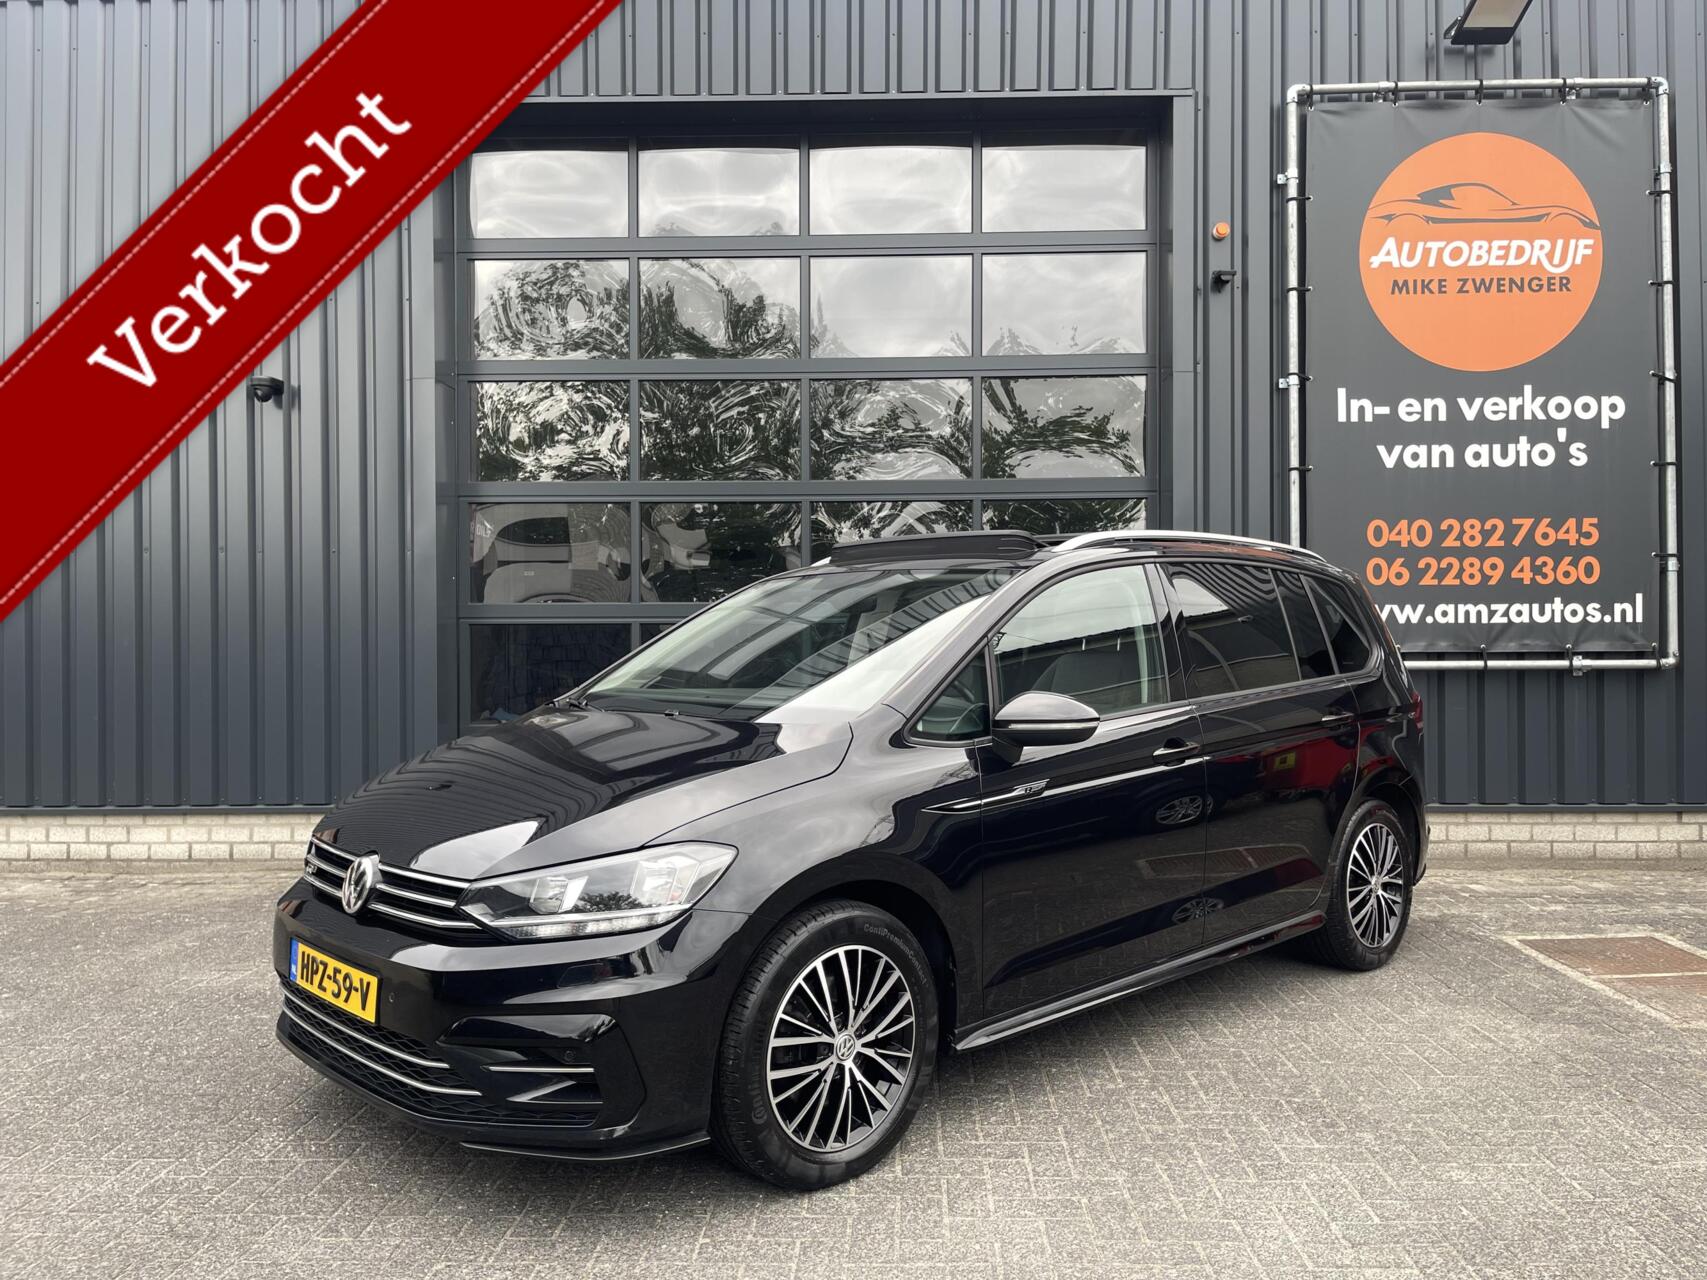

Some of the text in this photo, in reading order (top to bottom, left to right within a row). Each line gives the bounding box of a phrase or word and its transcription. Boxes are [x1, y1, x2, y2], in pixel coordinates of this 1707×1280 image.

[1369, 236, 1594, 274] AUTOBEDRIJF
[1390, 275, 1572, 296] MIKE ZWENGER
[1337, 384, 1626, 429] In- en verkoop
[1376, 427, 1588, 469] van auto's
[1366, 517, 1600, 548] 040 282 7645
[1366, 555, 1601, 587] 06 2289 4360
[301, 951, 371, 1012] HPZ-59-V
